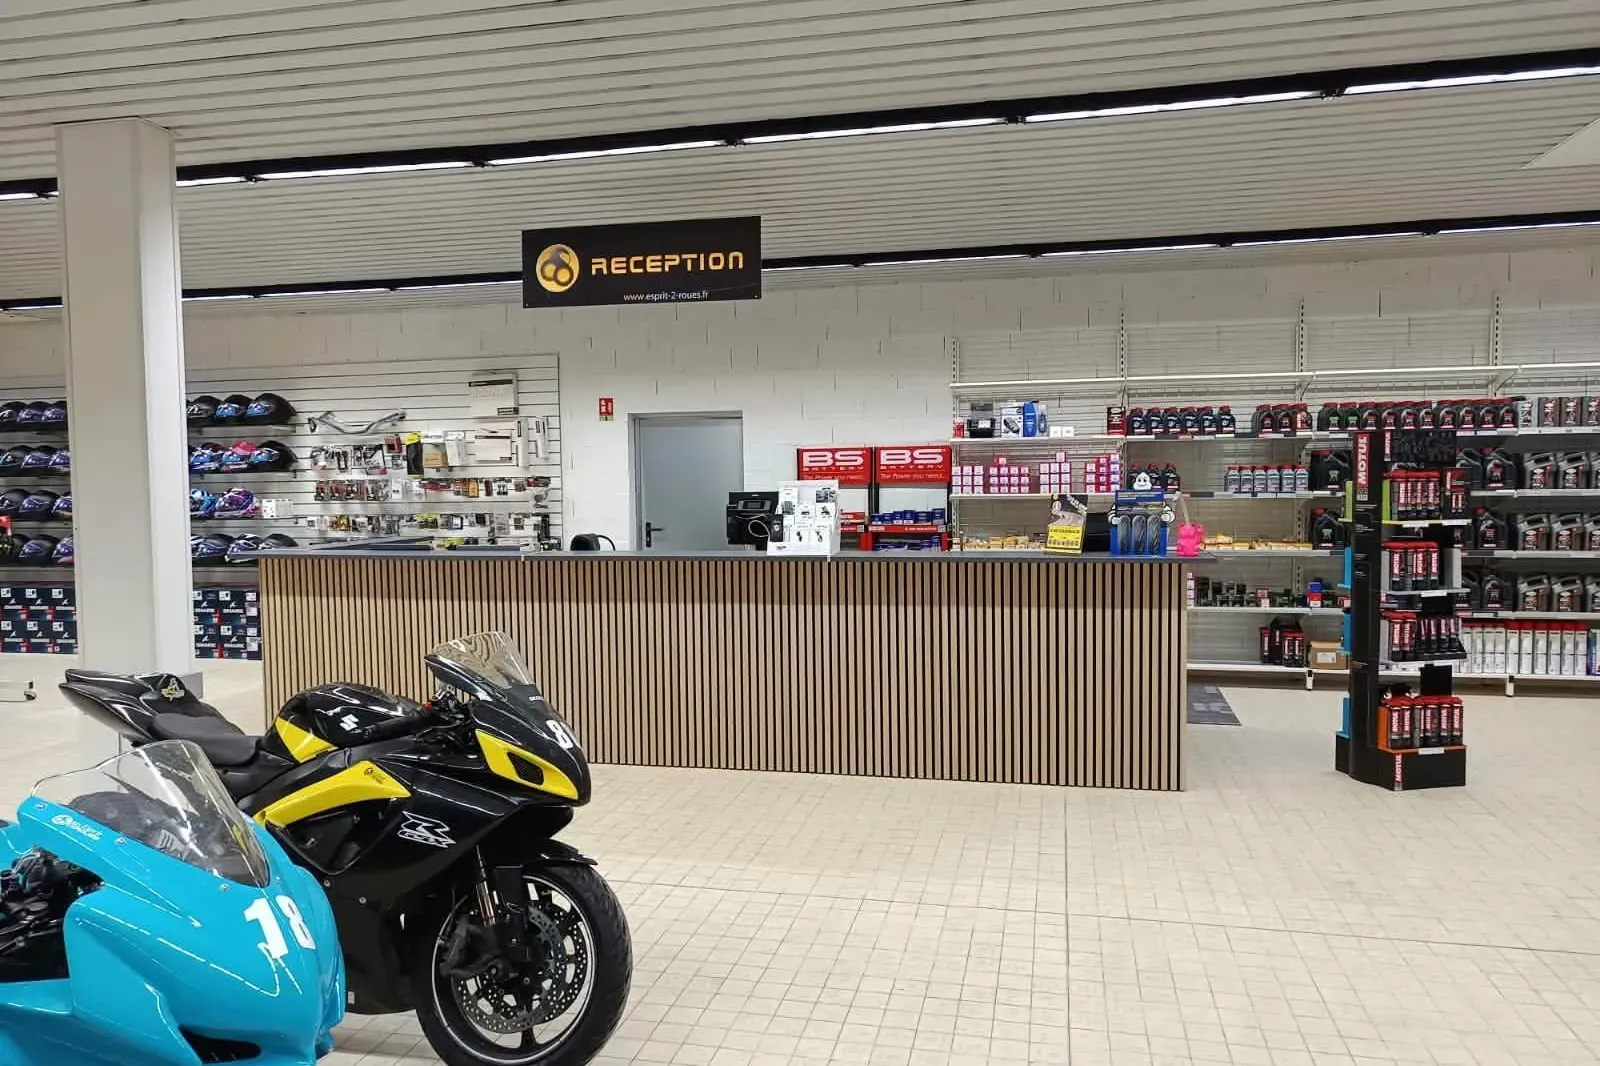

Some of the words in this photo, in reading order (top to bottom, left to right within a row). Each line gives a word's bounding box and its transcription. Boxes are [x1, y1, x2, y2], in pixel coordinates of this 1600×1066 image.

[591, 251, 743, 275] RECEPTION
[623, 290, 709, 301] www.esprit-2-roues.fr
[803, 450, 865, 467] BS
[880, 448, 945, 465] BS
[1357, 436, 1368, 485] MOTUL
[243, 894, 317, 960] 18
